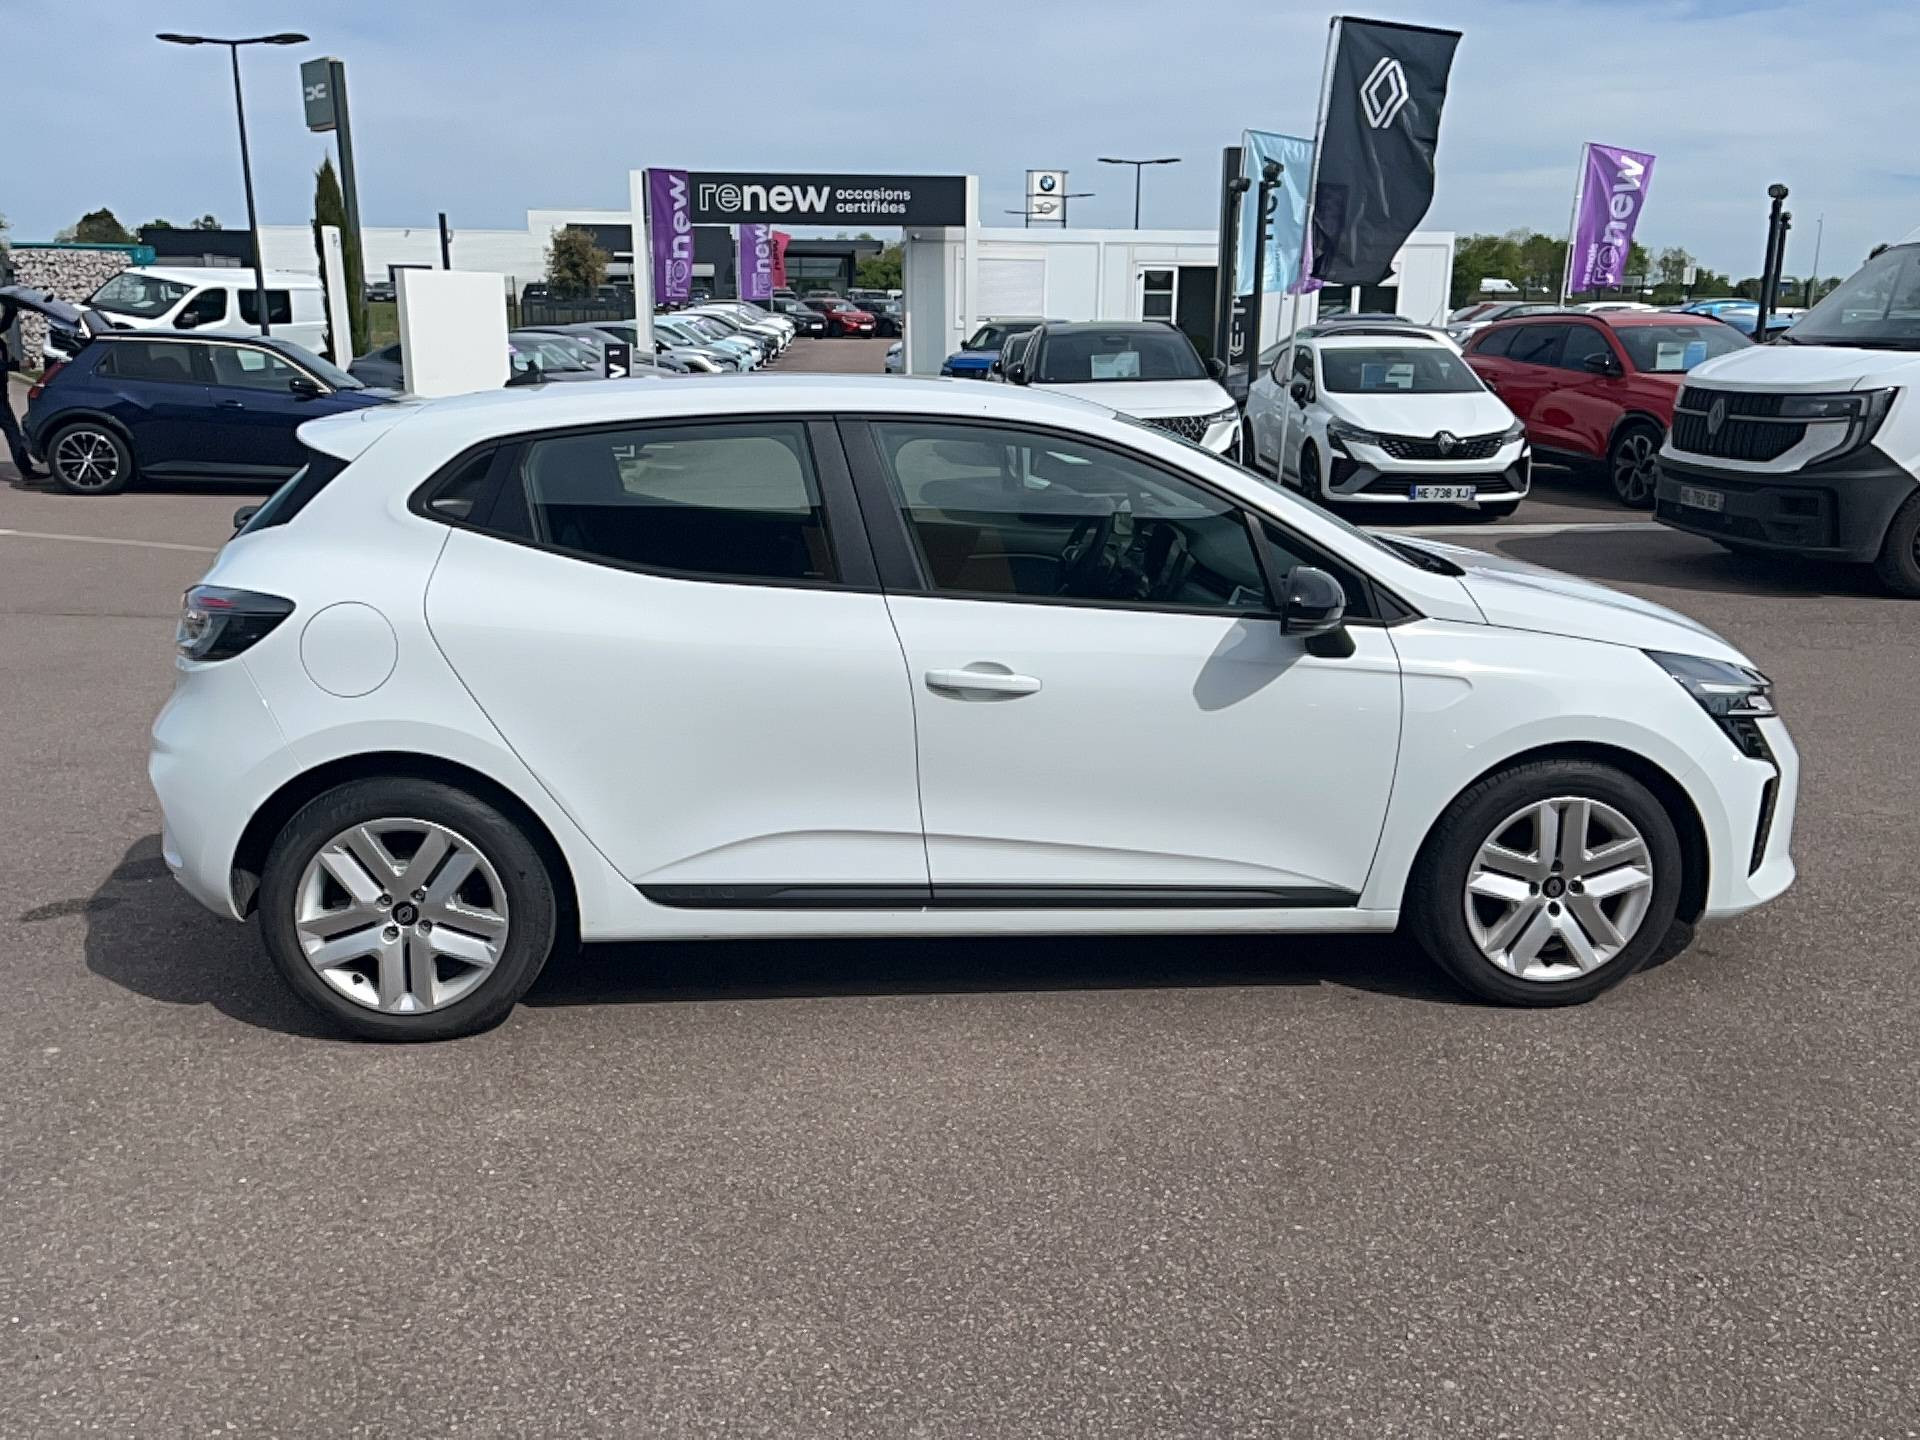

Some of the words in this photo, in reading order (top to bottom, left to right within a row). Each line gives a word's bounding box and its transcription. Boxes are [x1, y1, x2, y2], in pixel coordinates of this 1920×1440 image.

[699, 183, 831, 213] renew
[835, 187, 911, 201] occasions
[835, 200, 906, 214] certifiées
[669, 174, 692, 297] renew
